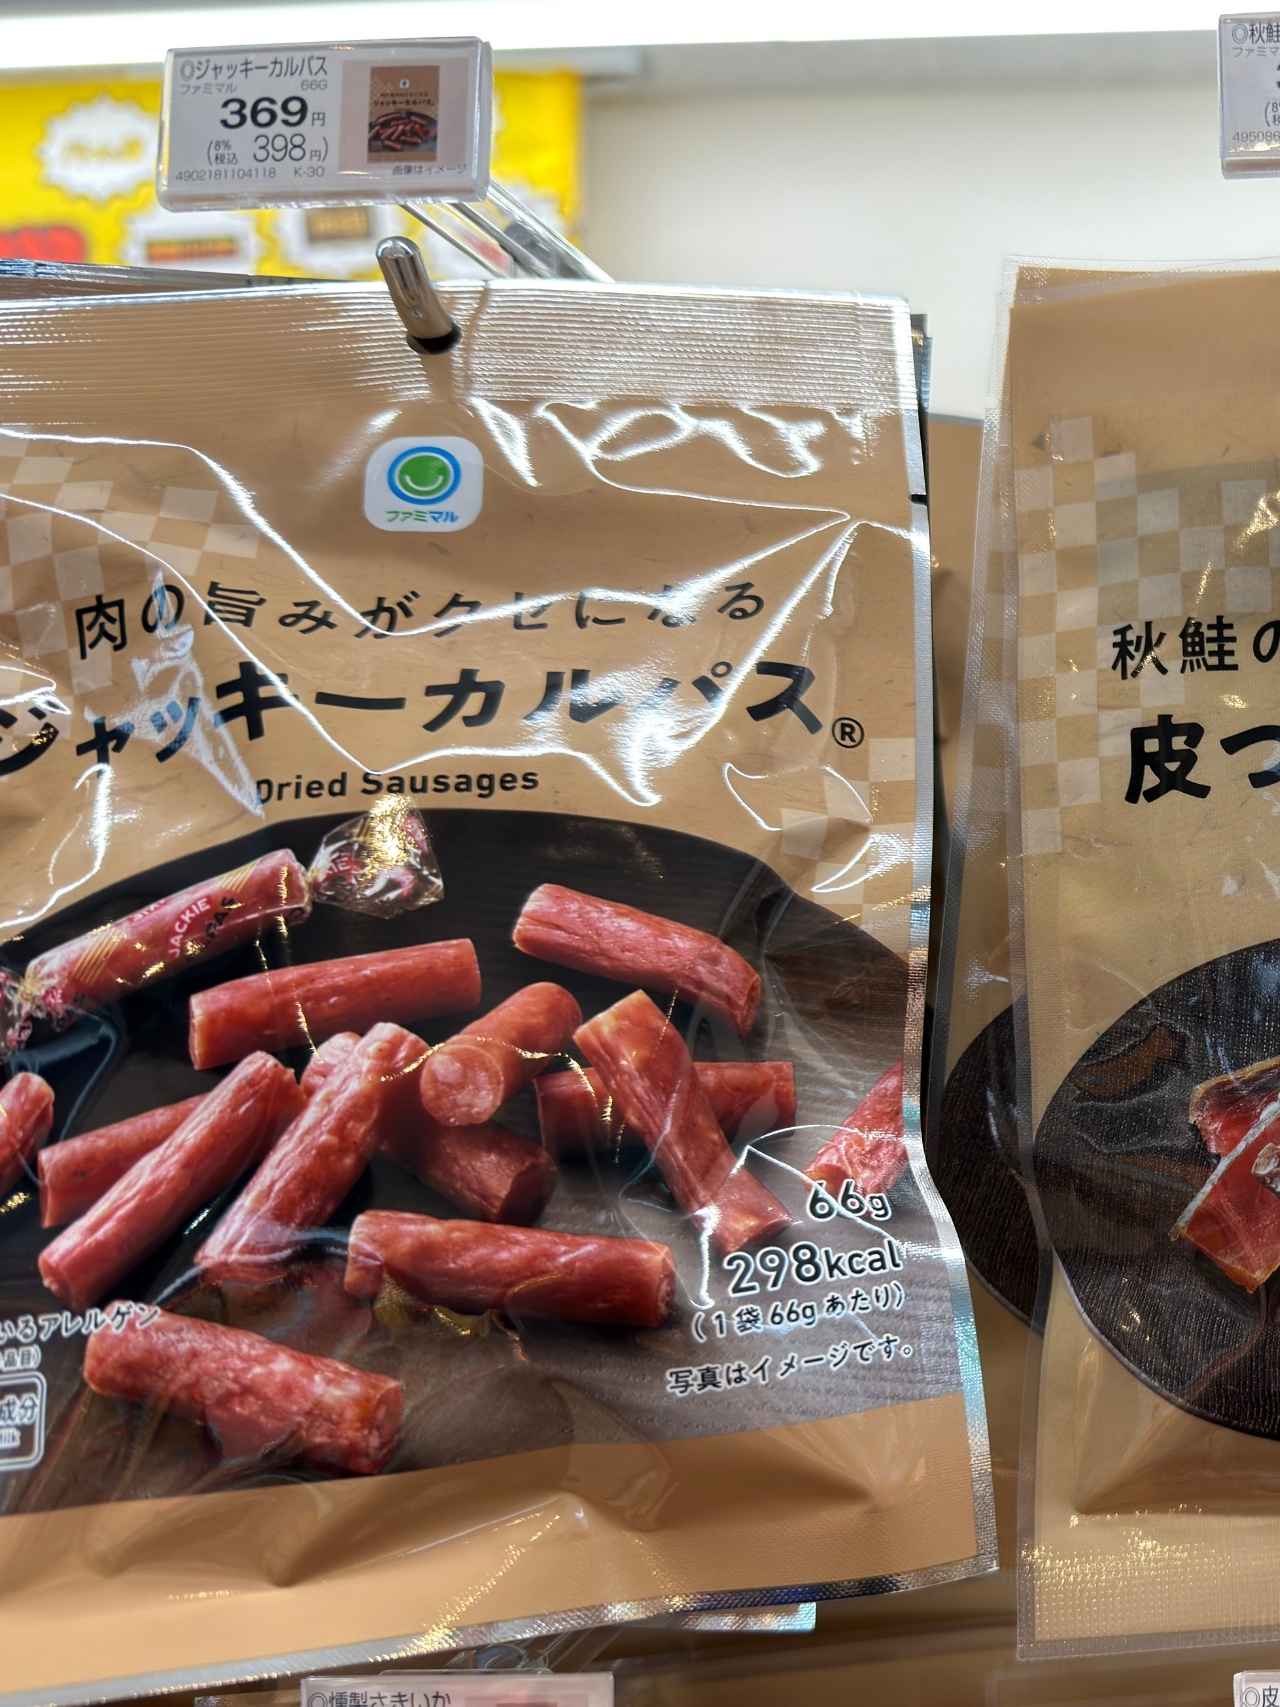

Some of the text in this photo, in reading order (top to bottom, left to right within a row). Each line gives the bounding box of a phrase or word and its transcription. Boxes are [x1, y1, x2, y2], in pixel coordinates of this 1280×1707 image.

[179, 84, 237, 95] ファミマル
[214, 153, 238, 166] 税込
[175, 167, 277, 182] 4902181104118
[385, 509, 459, 524] ファミマル
[360, 771, 539, 795] Sausages
[809, 1181, 890, 1219] 66g
[726, 1239, 901, 1295] 298kcal
[669, 1335, 912, 1394] 写真はイメージです。
